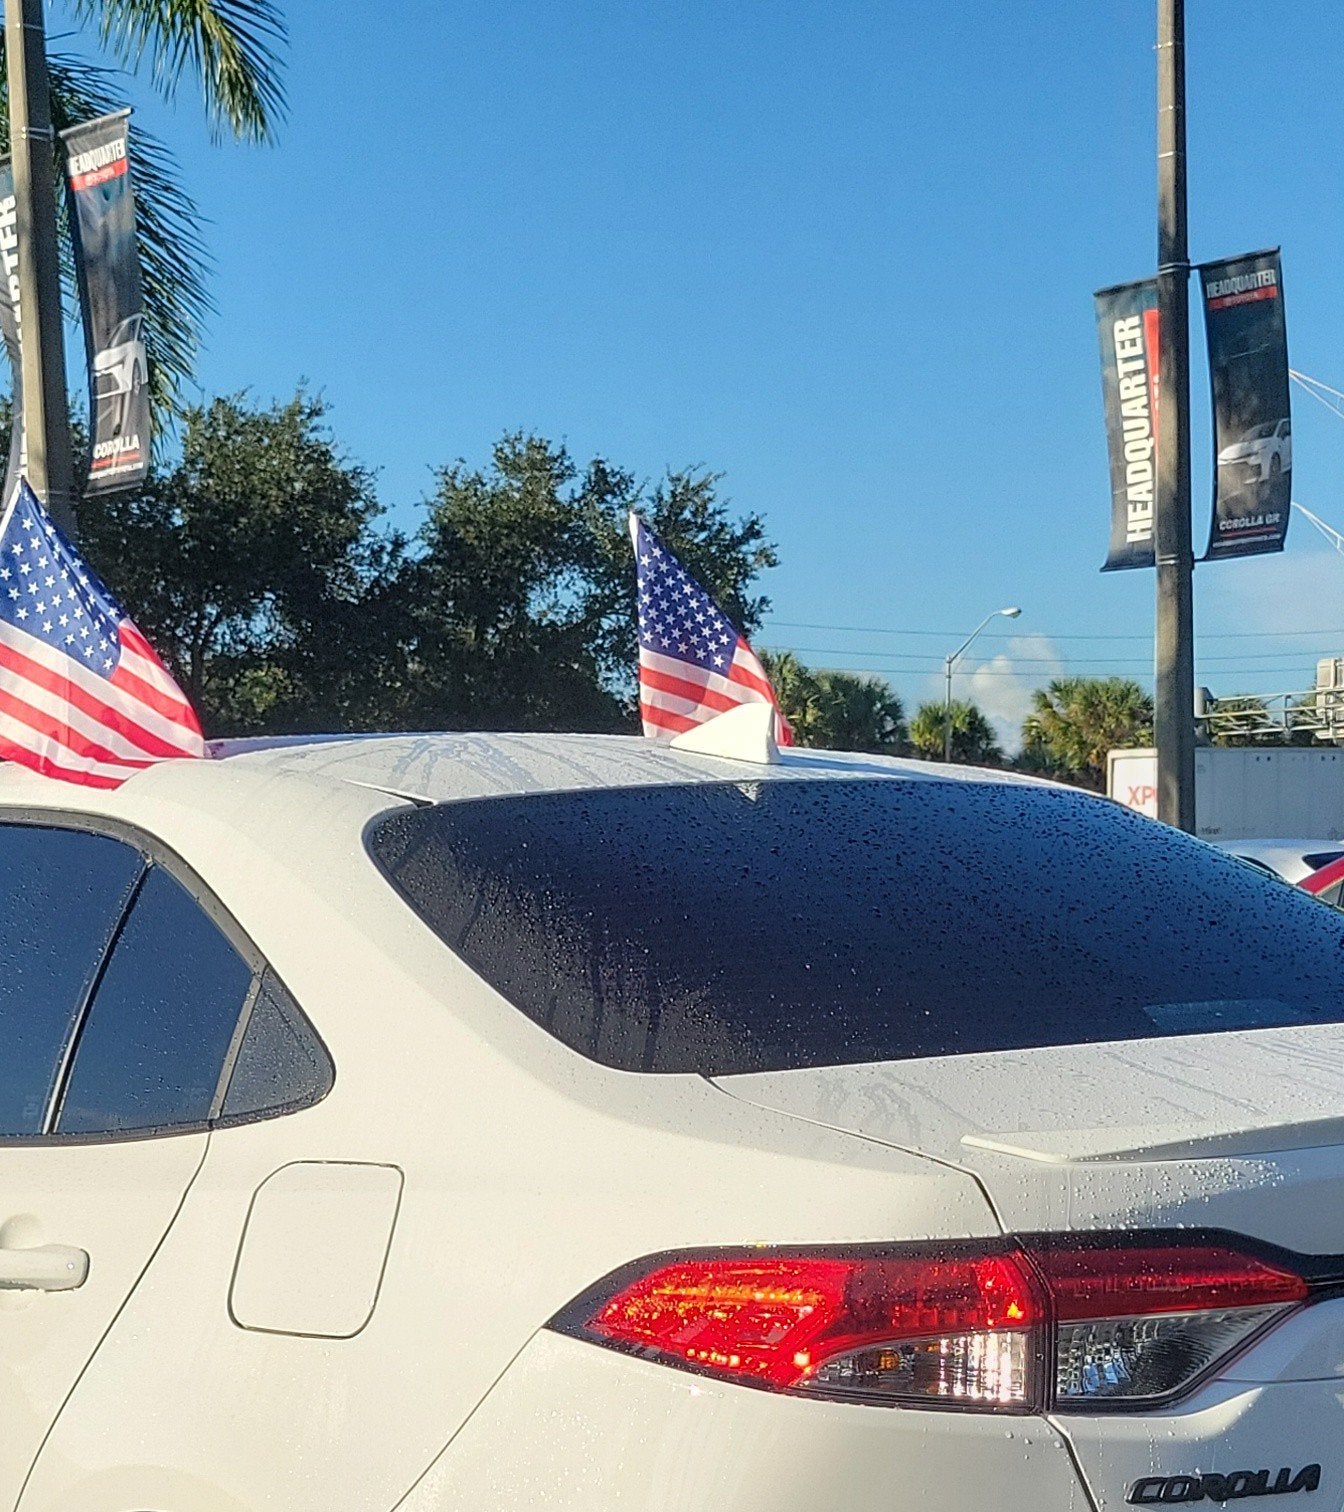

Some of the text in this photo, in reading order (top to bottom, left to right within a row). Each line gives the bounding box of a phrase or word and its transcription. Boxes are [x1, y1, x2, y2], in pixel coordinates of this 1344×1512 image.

[1114, 314, 1154, 543] HEADQUARTER
[93, 434, 140, 459] COROLLA
[1219, 515, 1263, 531] COROLLA
[1125, 1463, 1321, 1504] COROLLA
